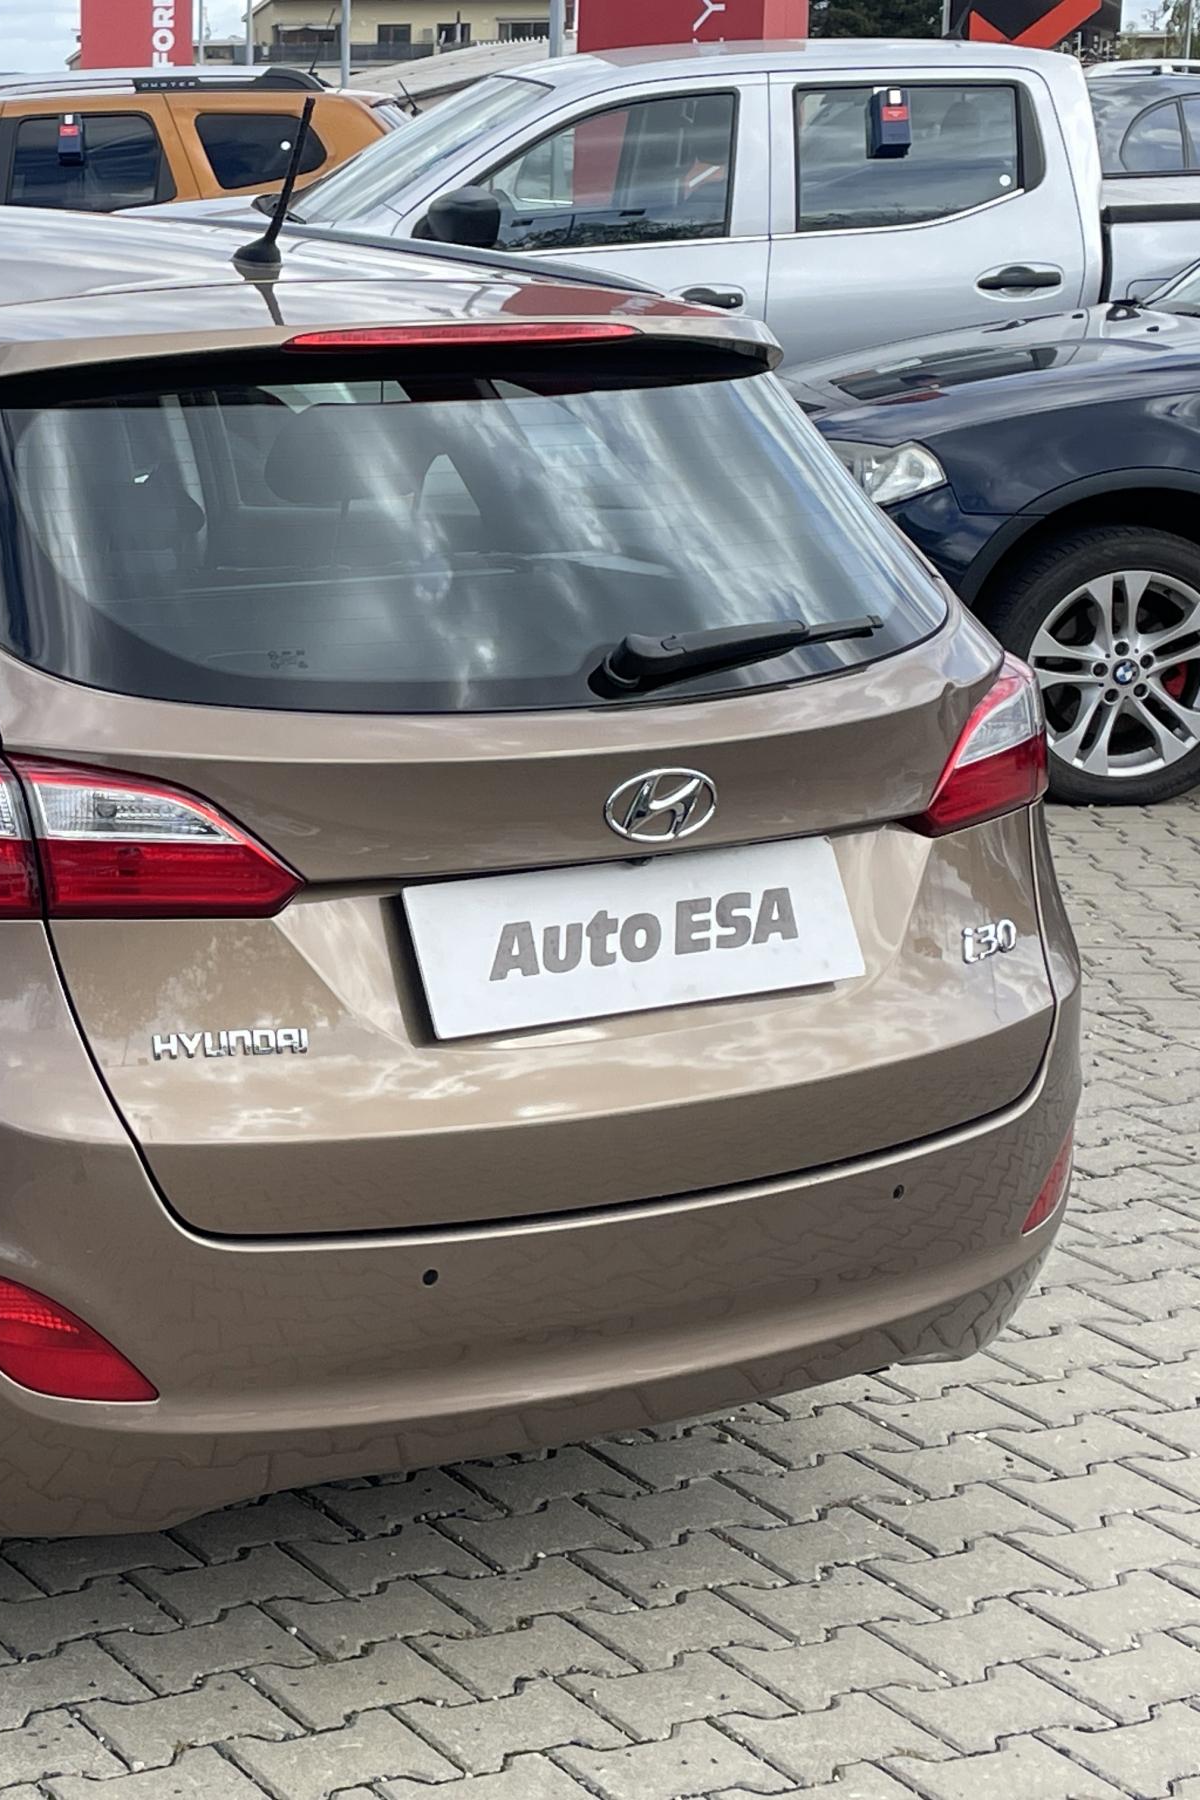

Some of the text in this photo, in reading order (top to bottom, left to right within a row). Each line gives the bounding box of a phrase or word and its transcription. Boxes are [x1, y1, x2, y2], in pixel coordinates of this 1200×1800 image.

[489, 887, 799, 981] Auto ESA
[962, 919, 1016, 964] i30
[152, 1028, 309, 1062] HYUNDAI
